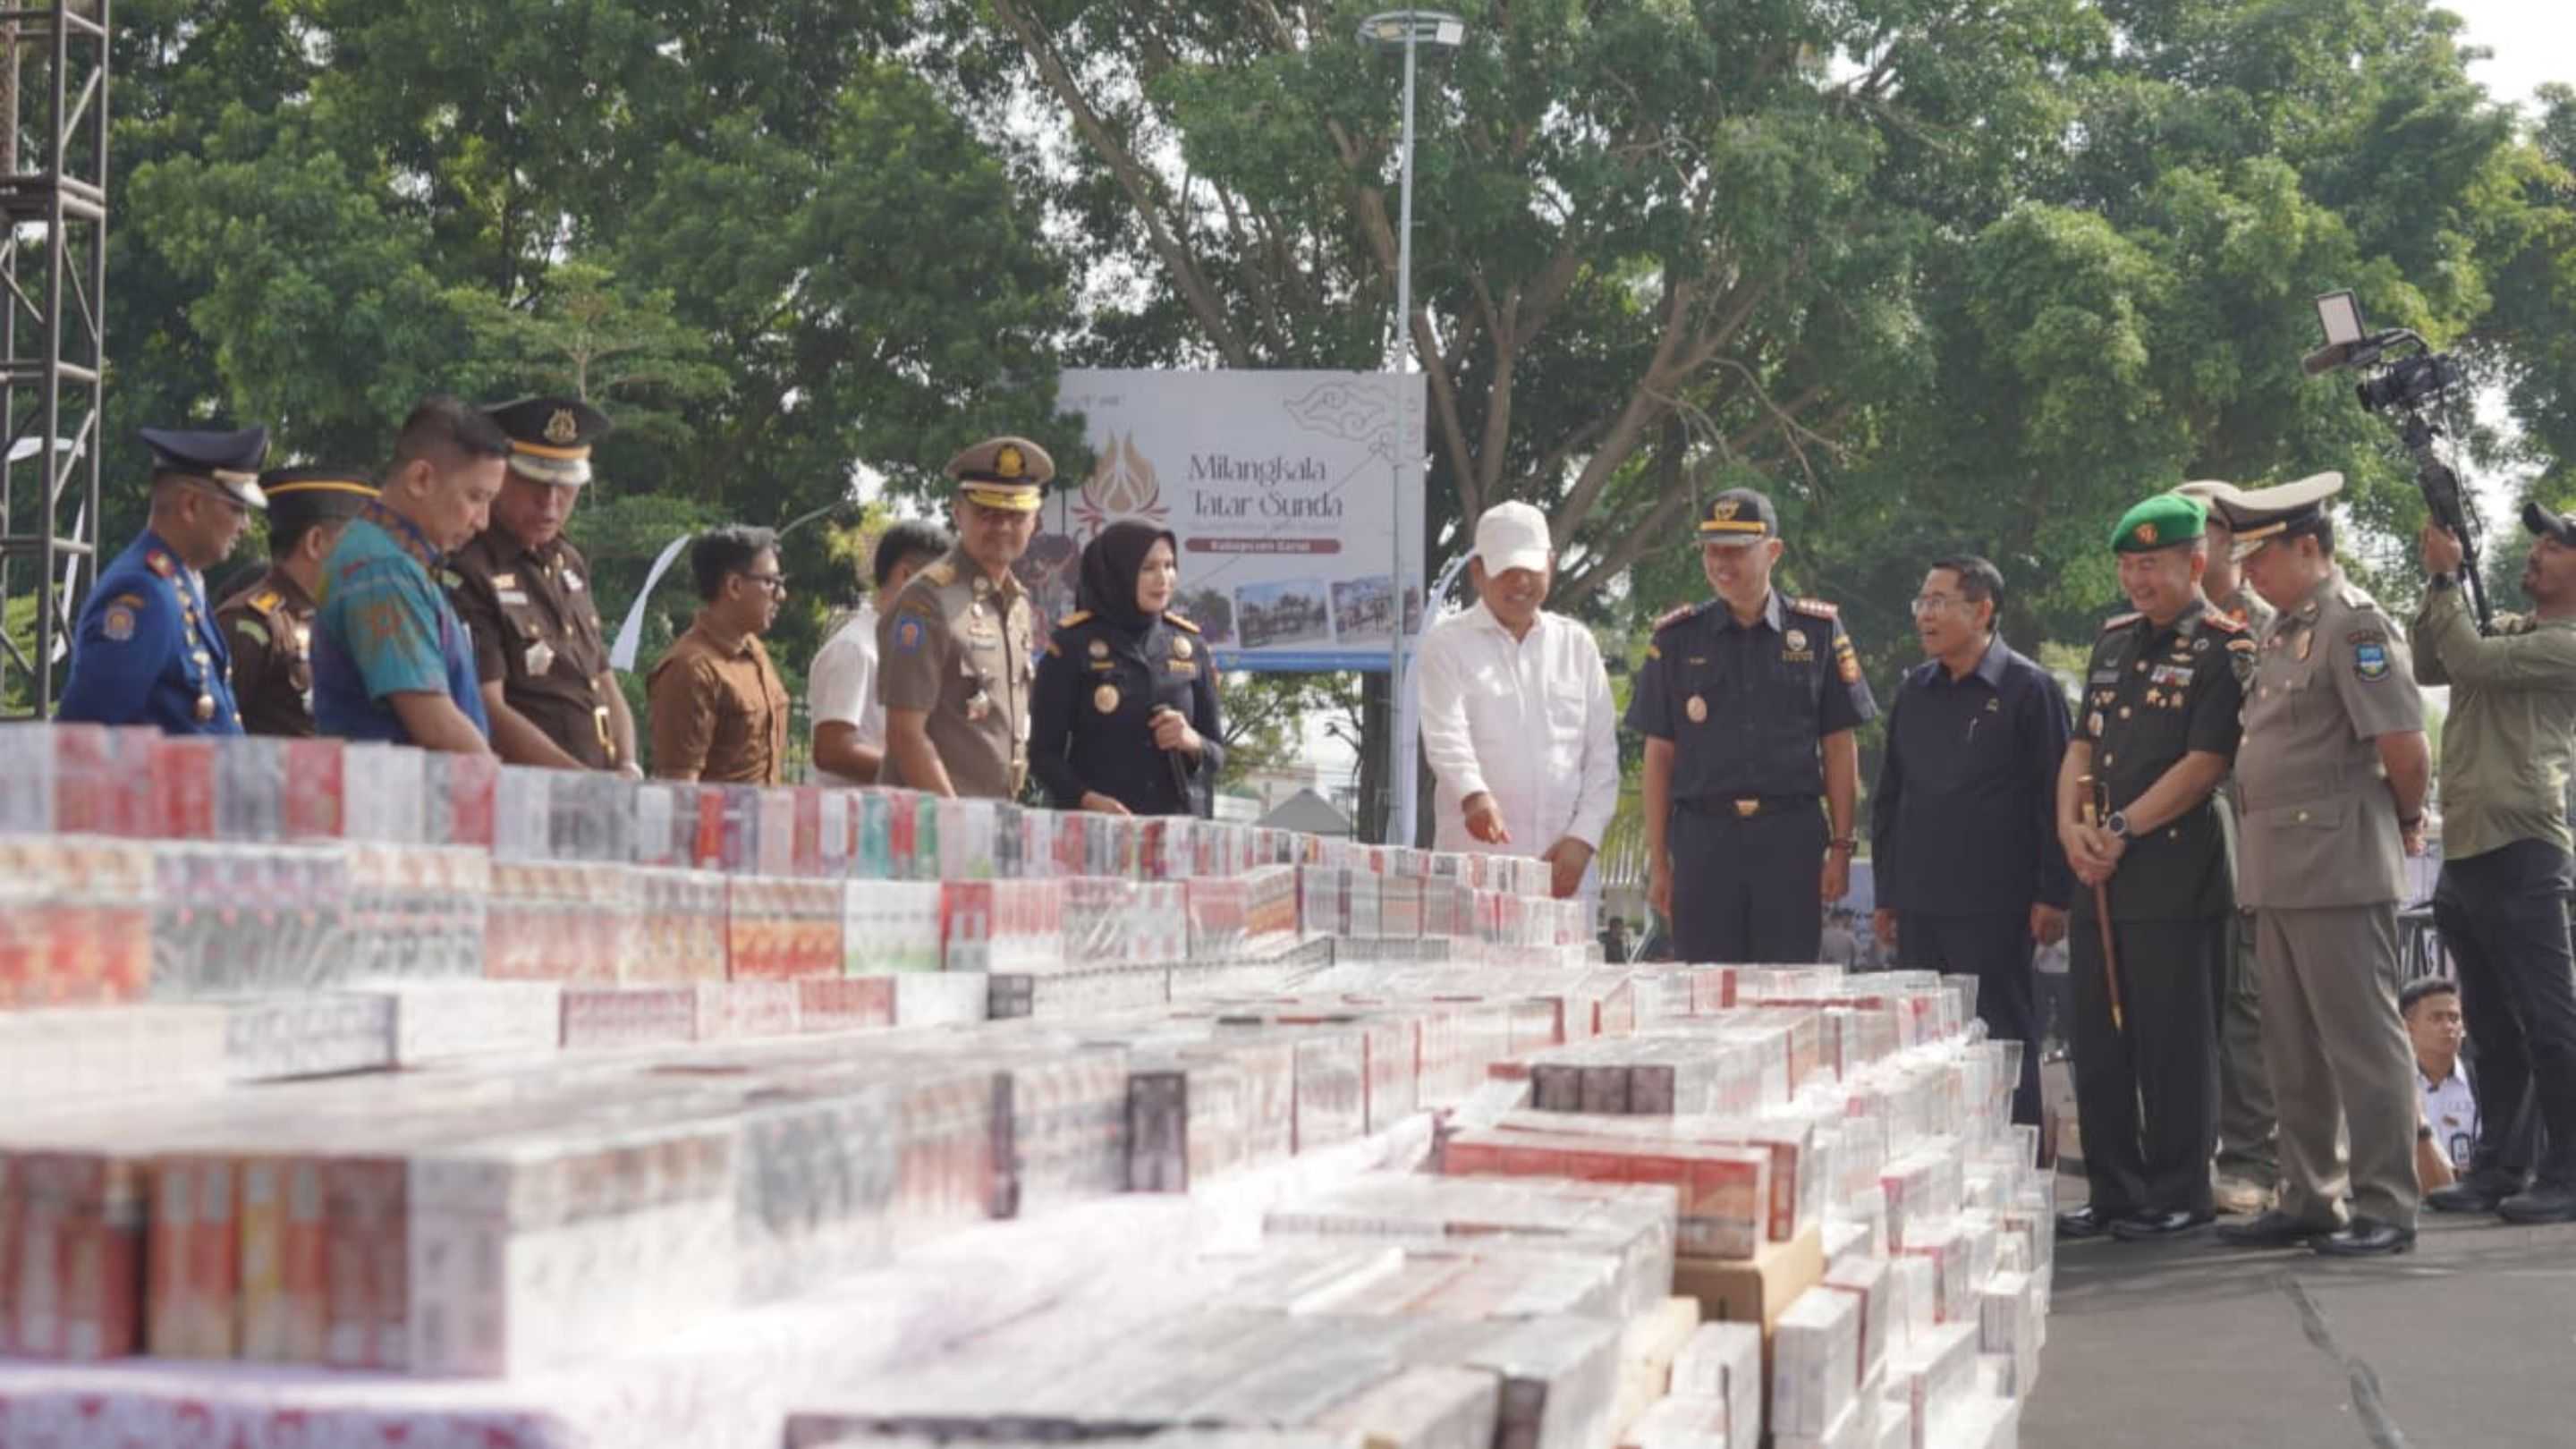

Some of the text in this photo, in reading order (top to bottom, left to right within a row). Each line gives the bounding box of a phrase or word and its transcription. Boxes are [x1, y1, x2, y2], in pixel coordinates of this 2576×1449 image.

[1190, 454, 1326, 486] Milangkala
[1190, 489, 1343, 518] Tatar Sunda
